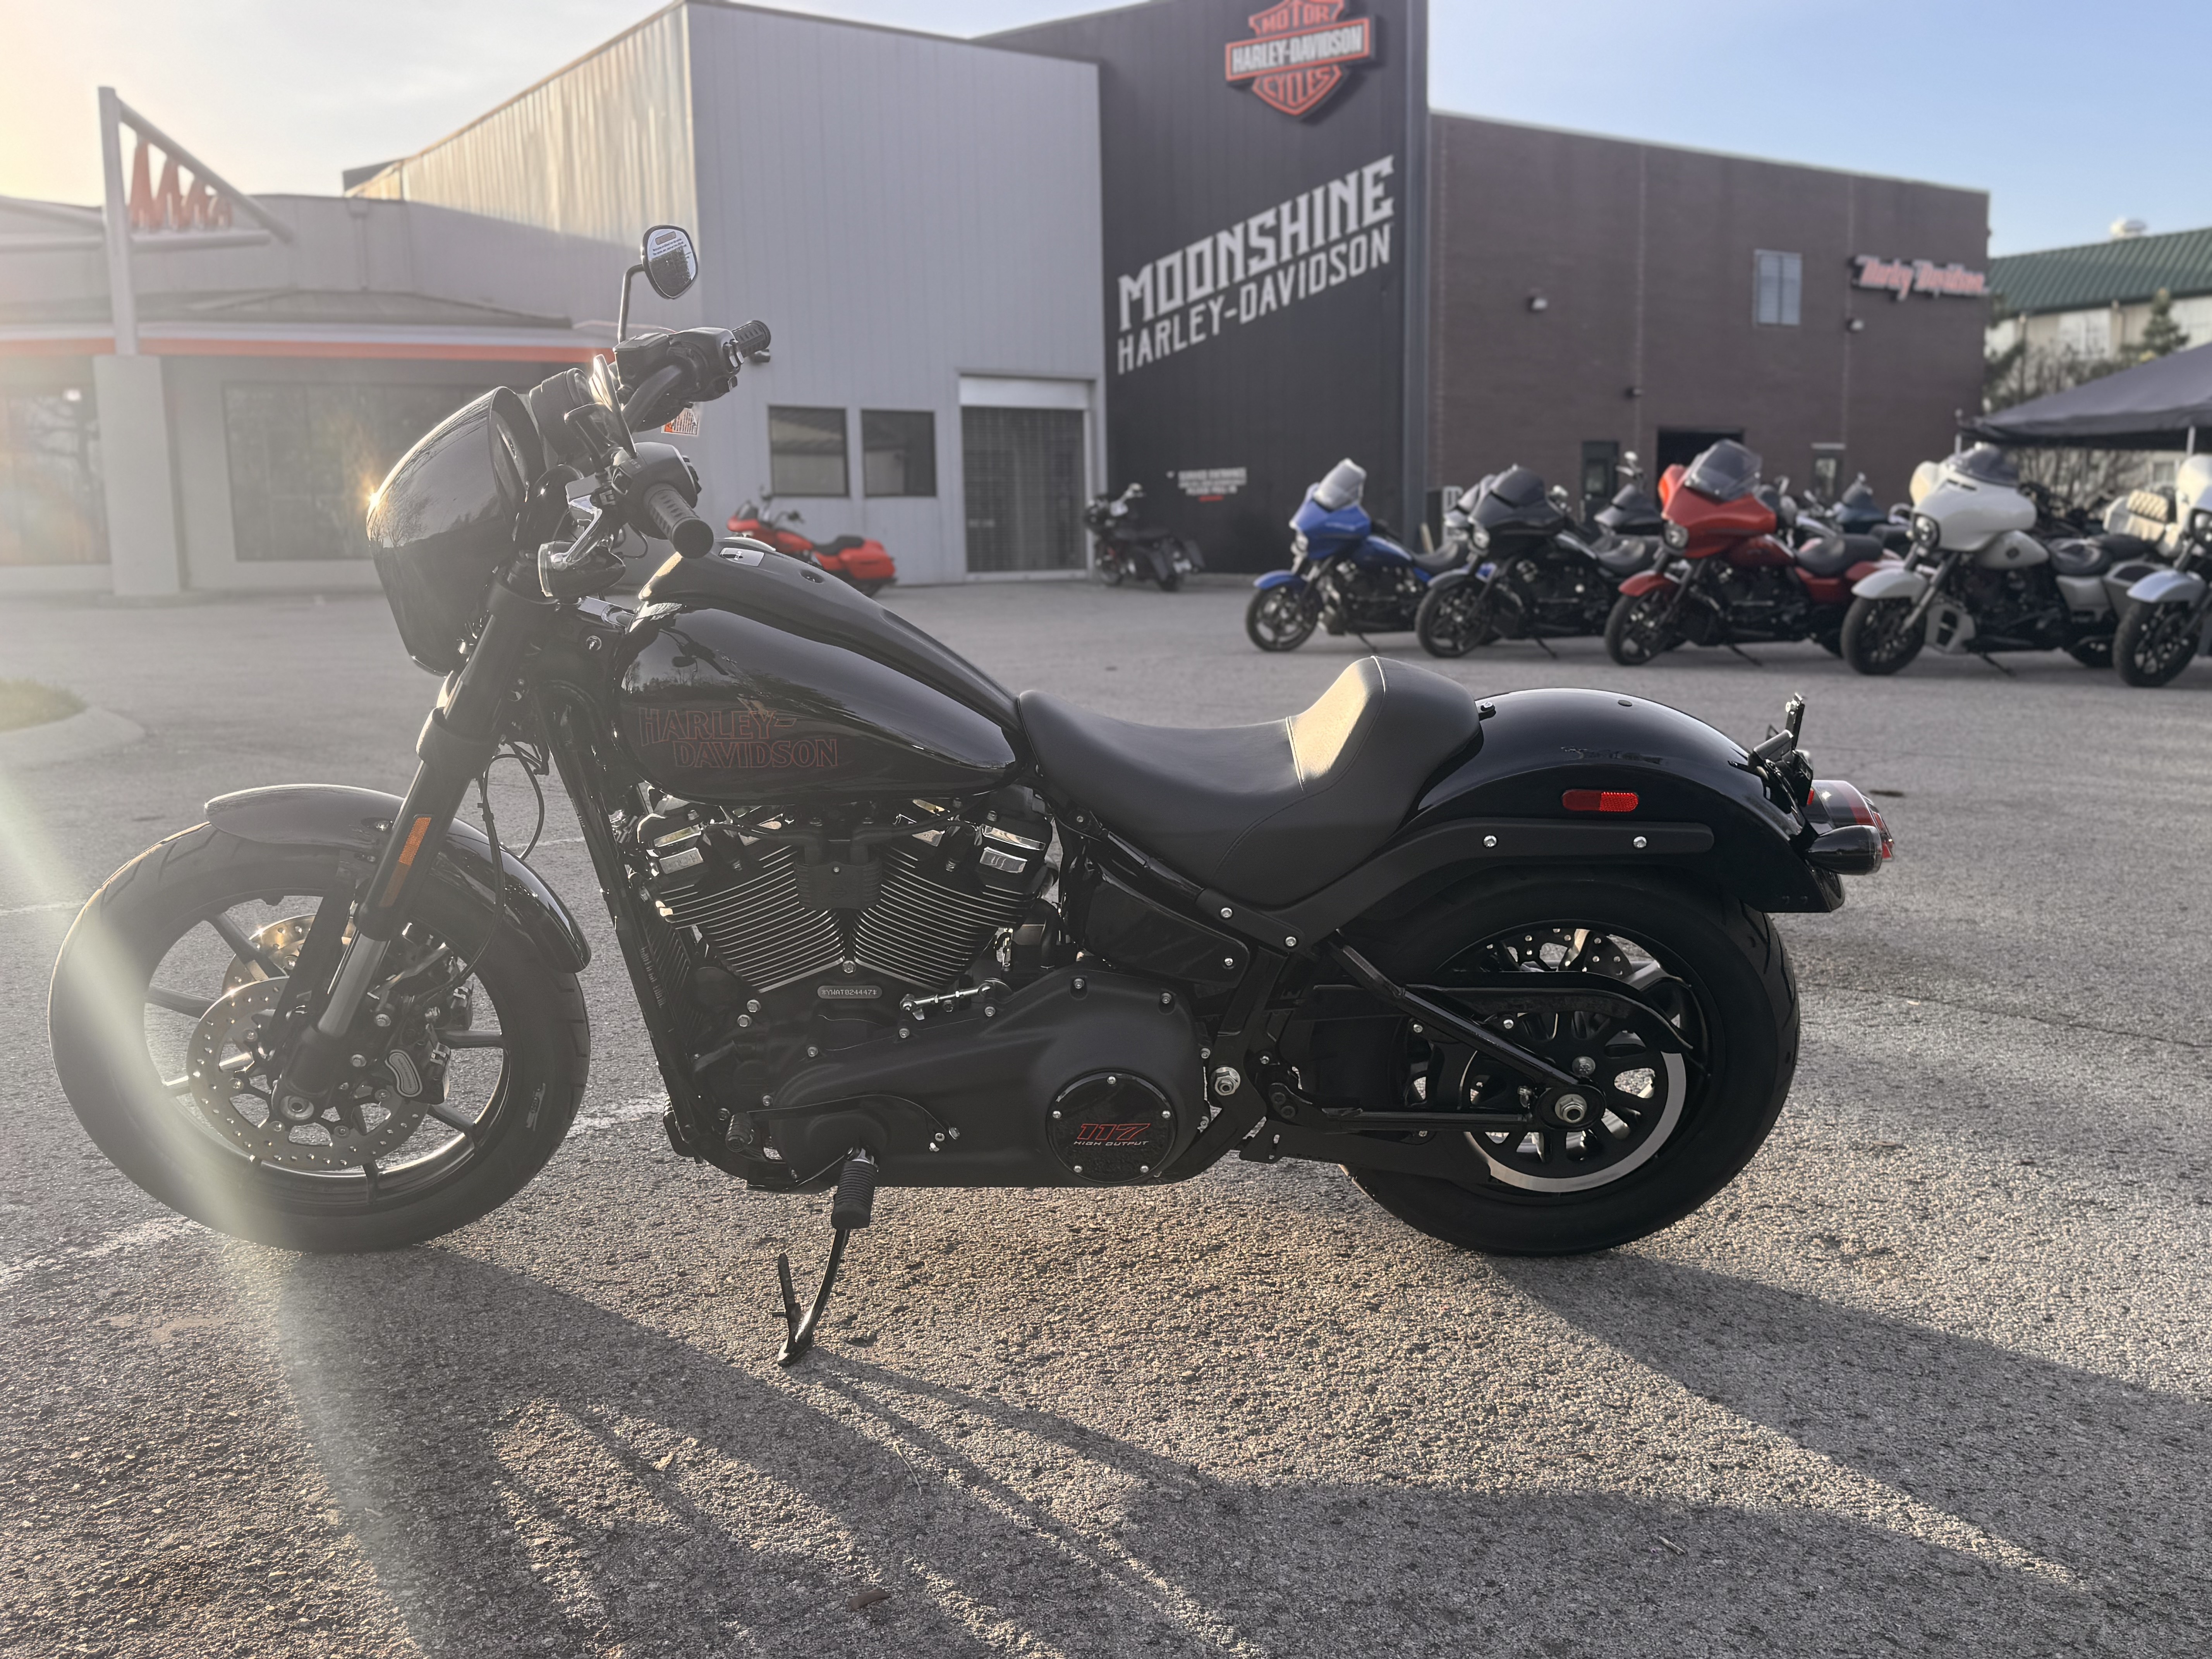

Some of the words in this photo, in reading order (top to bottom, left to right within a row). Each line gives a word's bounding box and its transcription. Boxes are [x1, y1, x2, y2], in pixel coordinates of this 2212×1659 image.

[1261, 2, 1330, 33] MOTOR
[1232, 24, 1363, 74] HARLEY-DAVIDSON
[1263, 67, 1331, 106] CYCLES
[1118, 155, 1394, 332] MOONSHINE
[1118, 223, 1390, 374] HARLEY-DAVIDSON
[673, 739, 838, 768] DAVIDSON
[1077, 1123, 1151, 1140] 117
